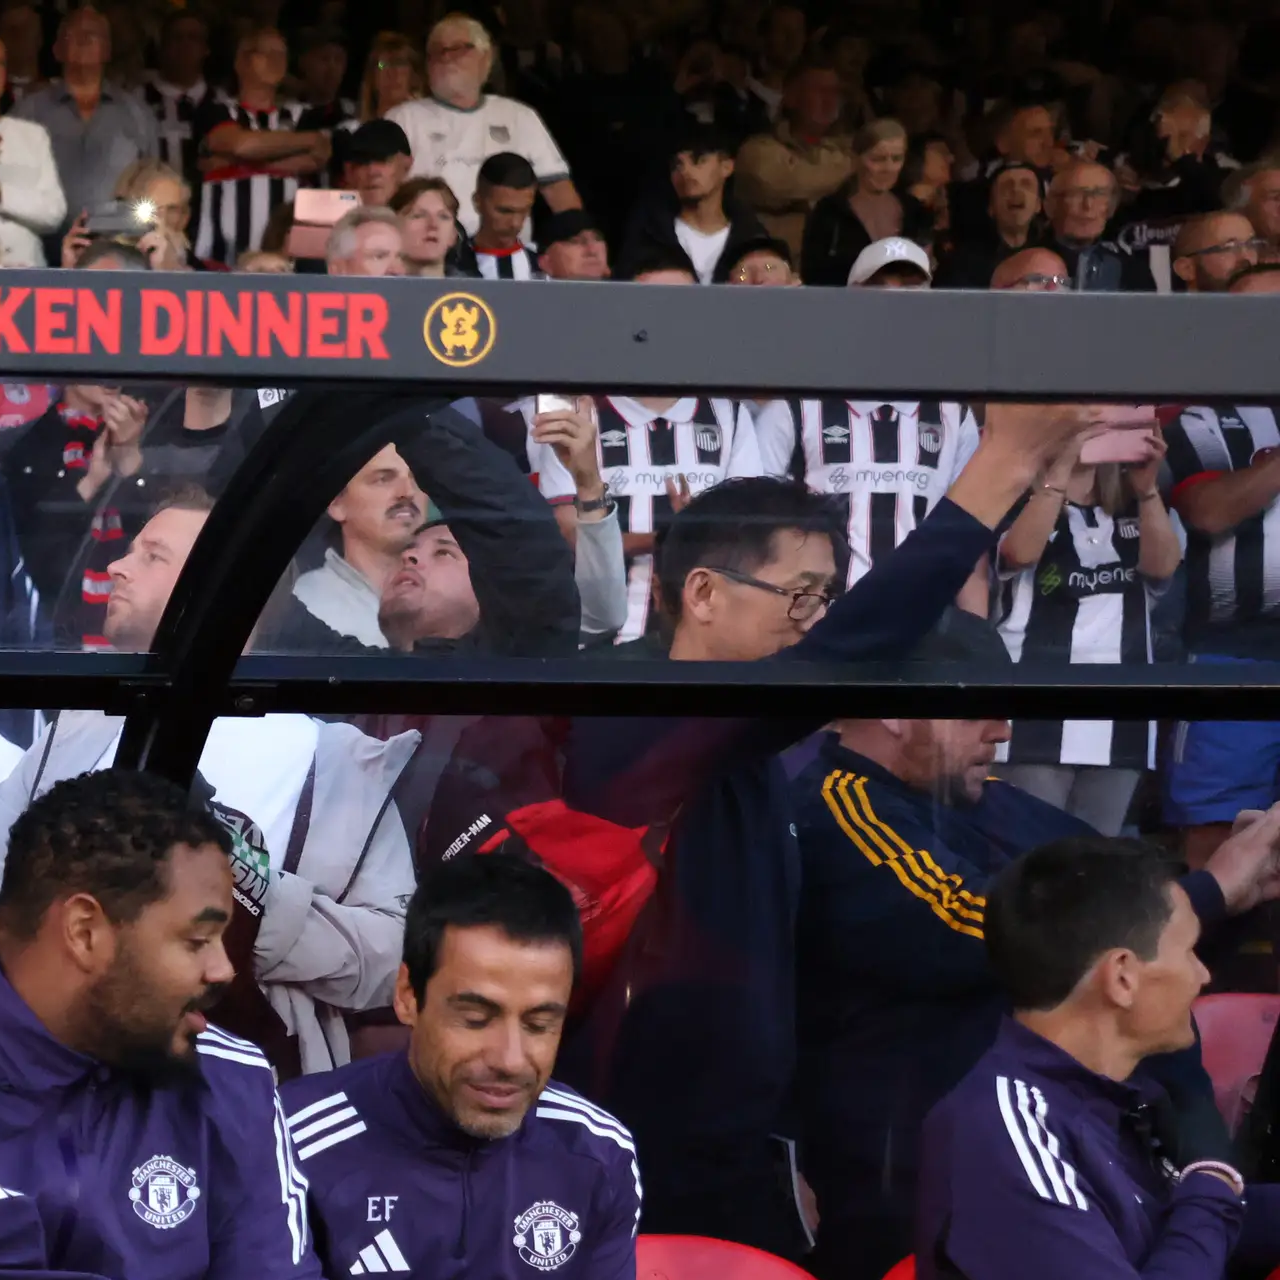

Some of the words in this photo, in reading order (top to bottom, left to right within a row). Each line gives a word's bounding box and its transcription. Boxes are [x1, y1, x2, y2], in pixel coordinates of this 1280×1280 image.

[139, 288, 391, 360] DINNER
[442, 813, 492, 862] SPIDER-MAN
[136, 1160, 191, 1185] MANCHESTER
[144, 1210, 186, 1224] UNITED
[366, 1196, 399, 1222] EF
[519, 1206, 574, 1230] MANCHESTER
[529, 1253, 567, 1267] UNITED
